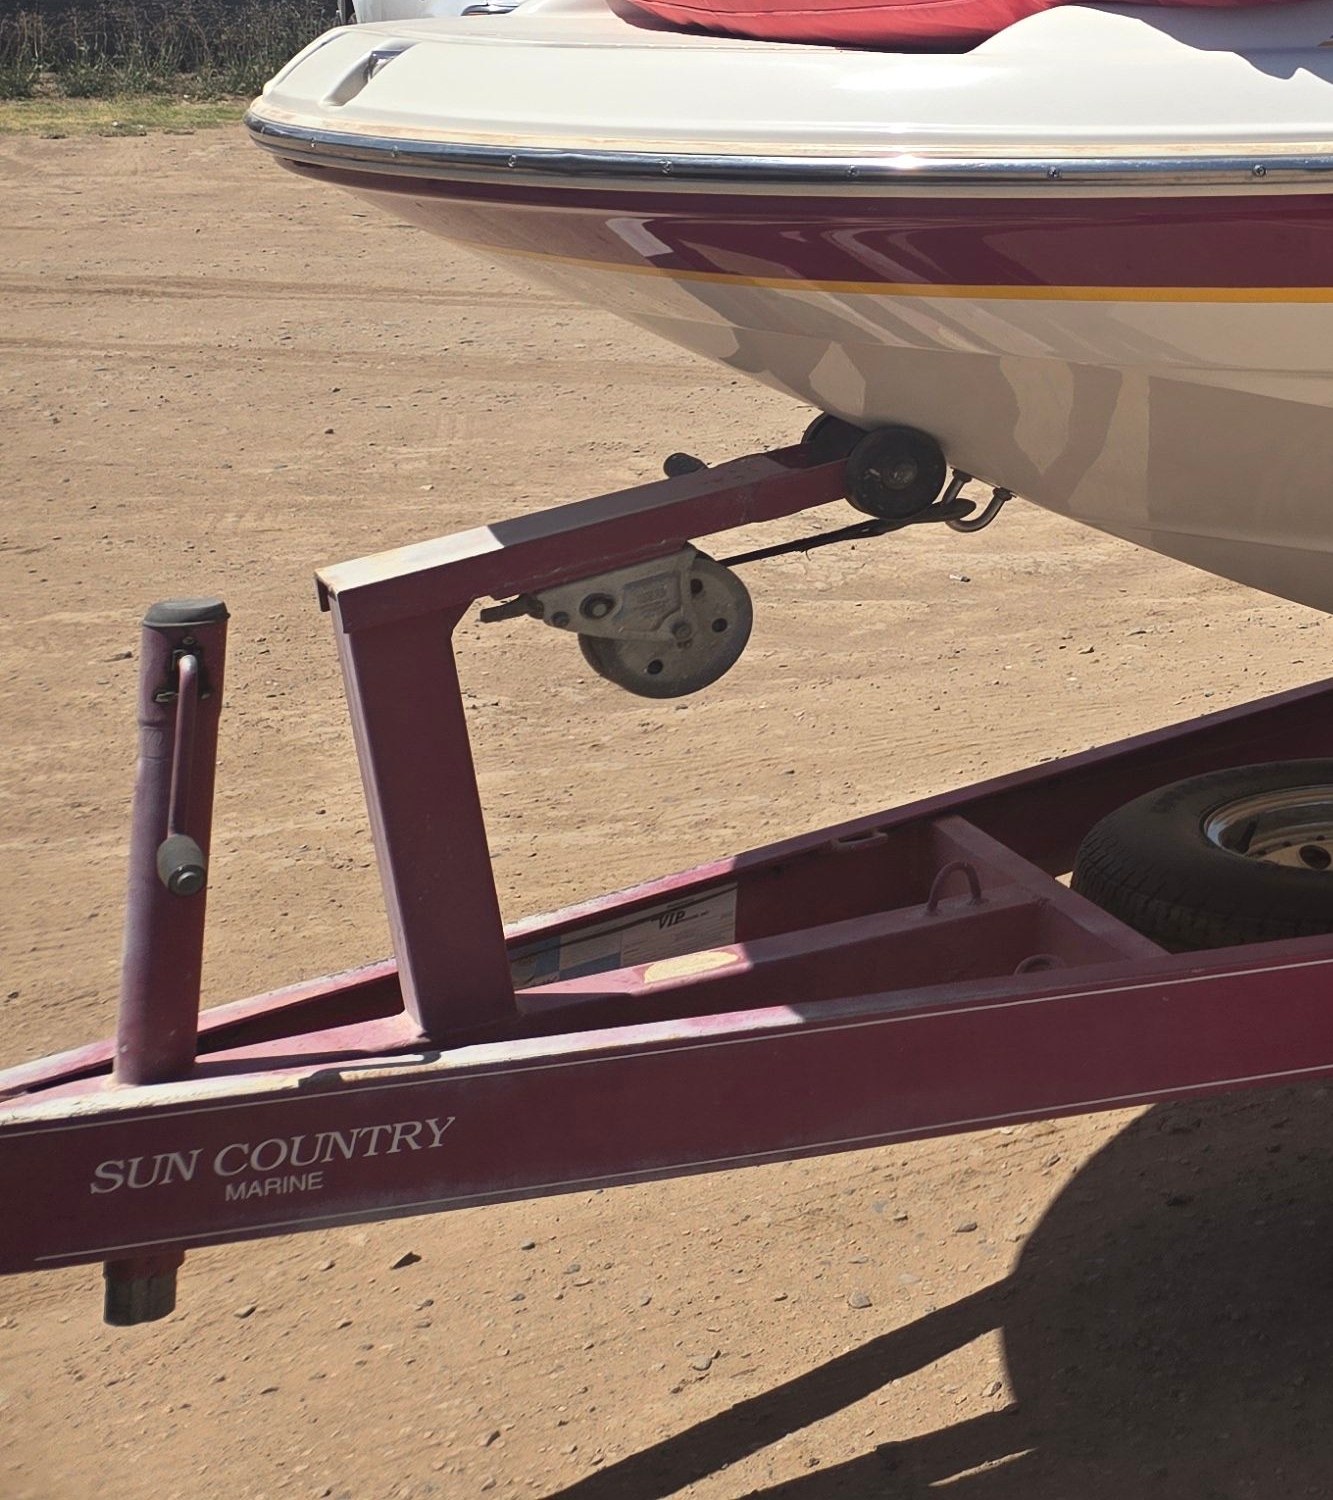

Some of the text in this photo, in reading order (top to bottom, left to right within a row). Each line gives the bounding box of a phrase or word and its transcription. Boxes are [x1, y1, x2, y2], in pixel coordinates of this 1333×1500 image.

[90, 1116, 456, 1195] SUN COUNTRY
[225, 1171, 324, 1201] MARINE
